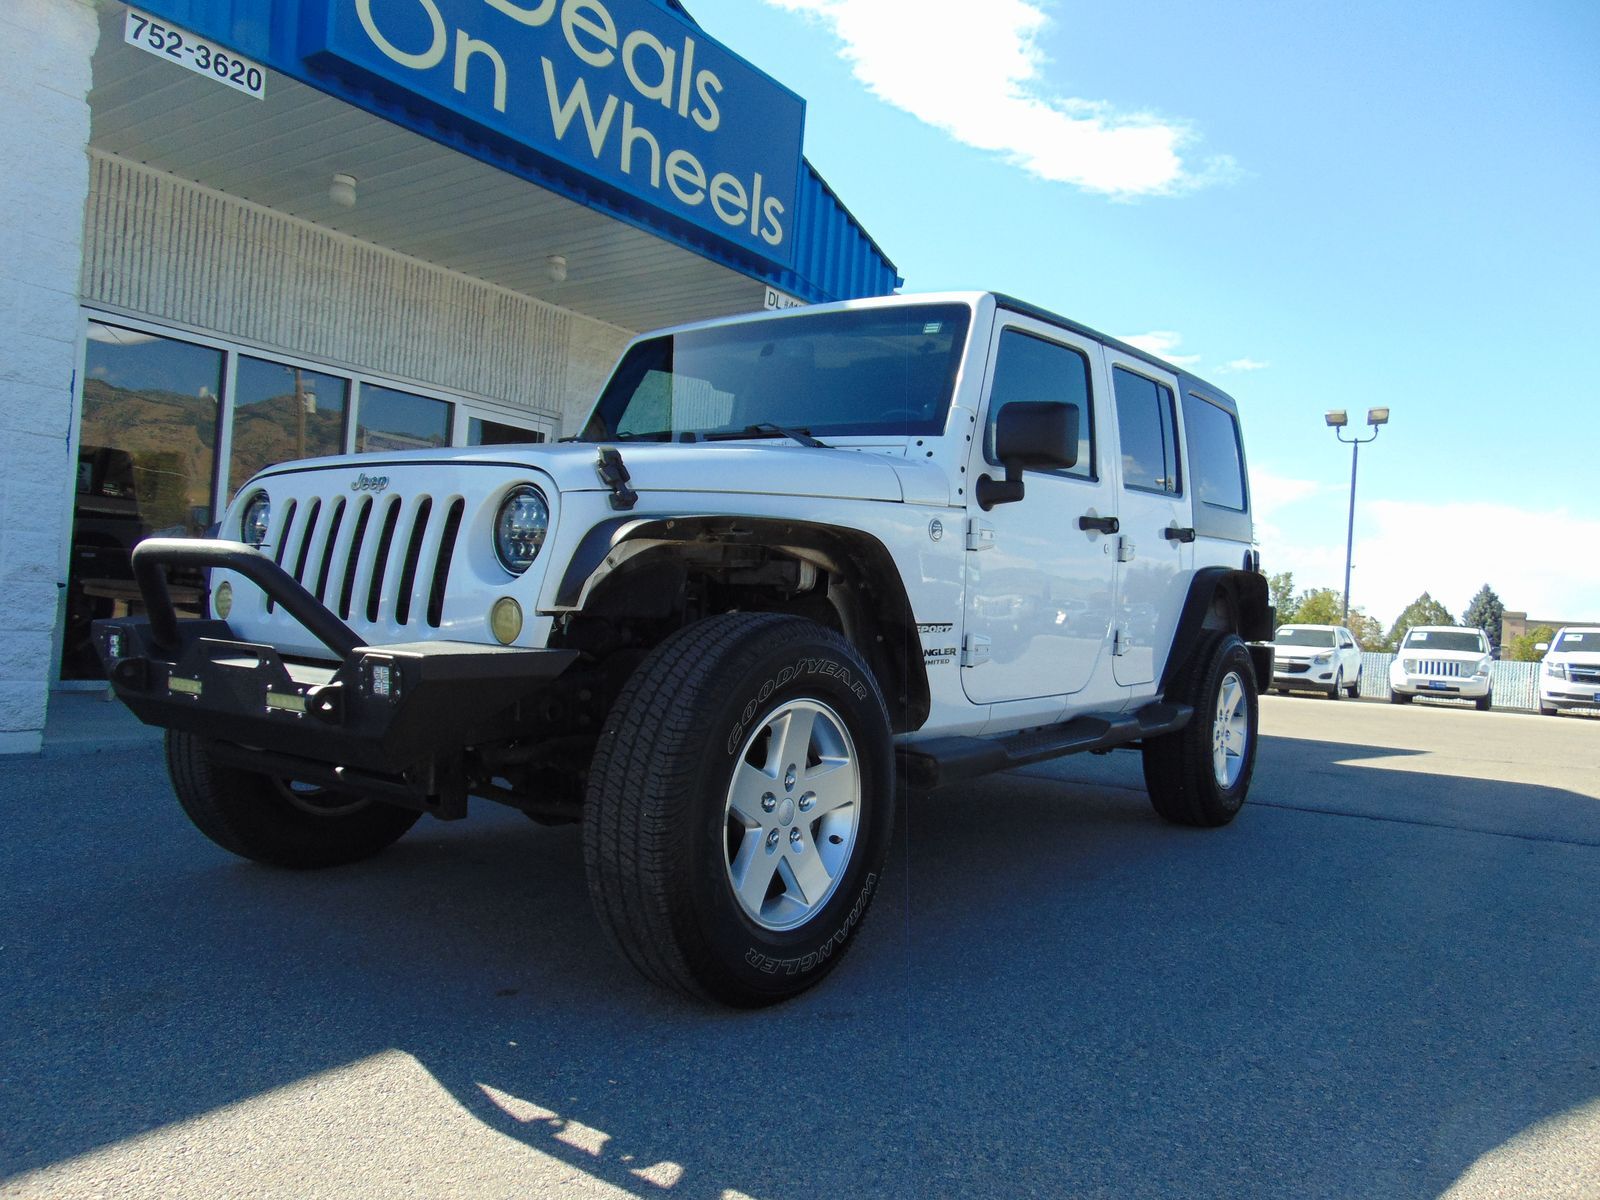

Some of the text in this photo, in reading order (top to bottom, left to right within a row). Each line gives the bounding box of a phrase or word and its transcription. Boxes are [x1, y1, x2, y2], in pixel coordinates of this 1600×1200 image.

[131, 13, 262, 92] 752-3620
[483, 0, 724, 132] eals
[541, 56, 785, 246] Wheels
[768, 291, 781, 310] DL
[351, 473, 390, 494] Jeep
[728, 658, 868, 755] GOODYEAR
[745, 872, 877, 975] WRANGLER
